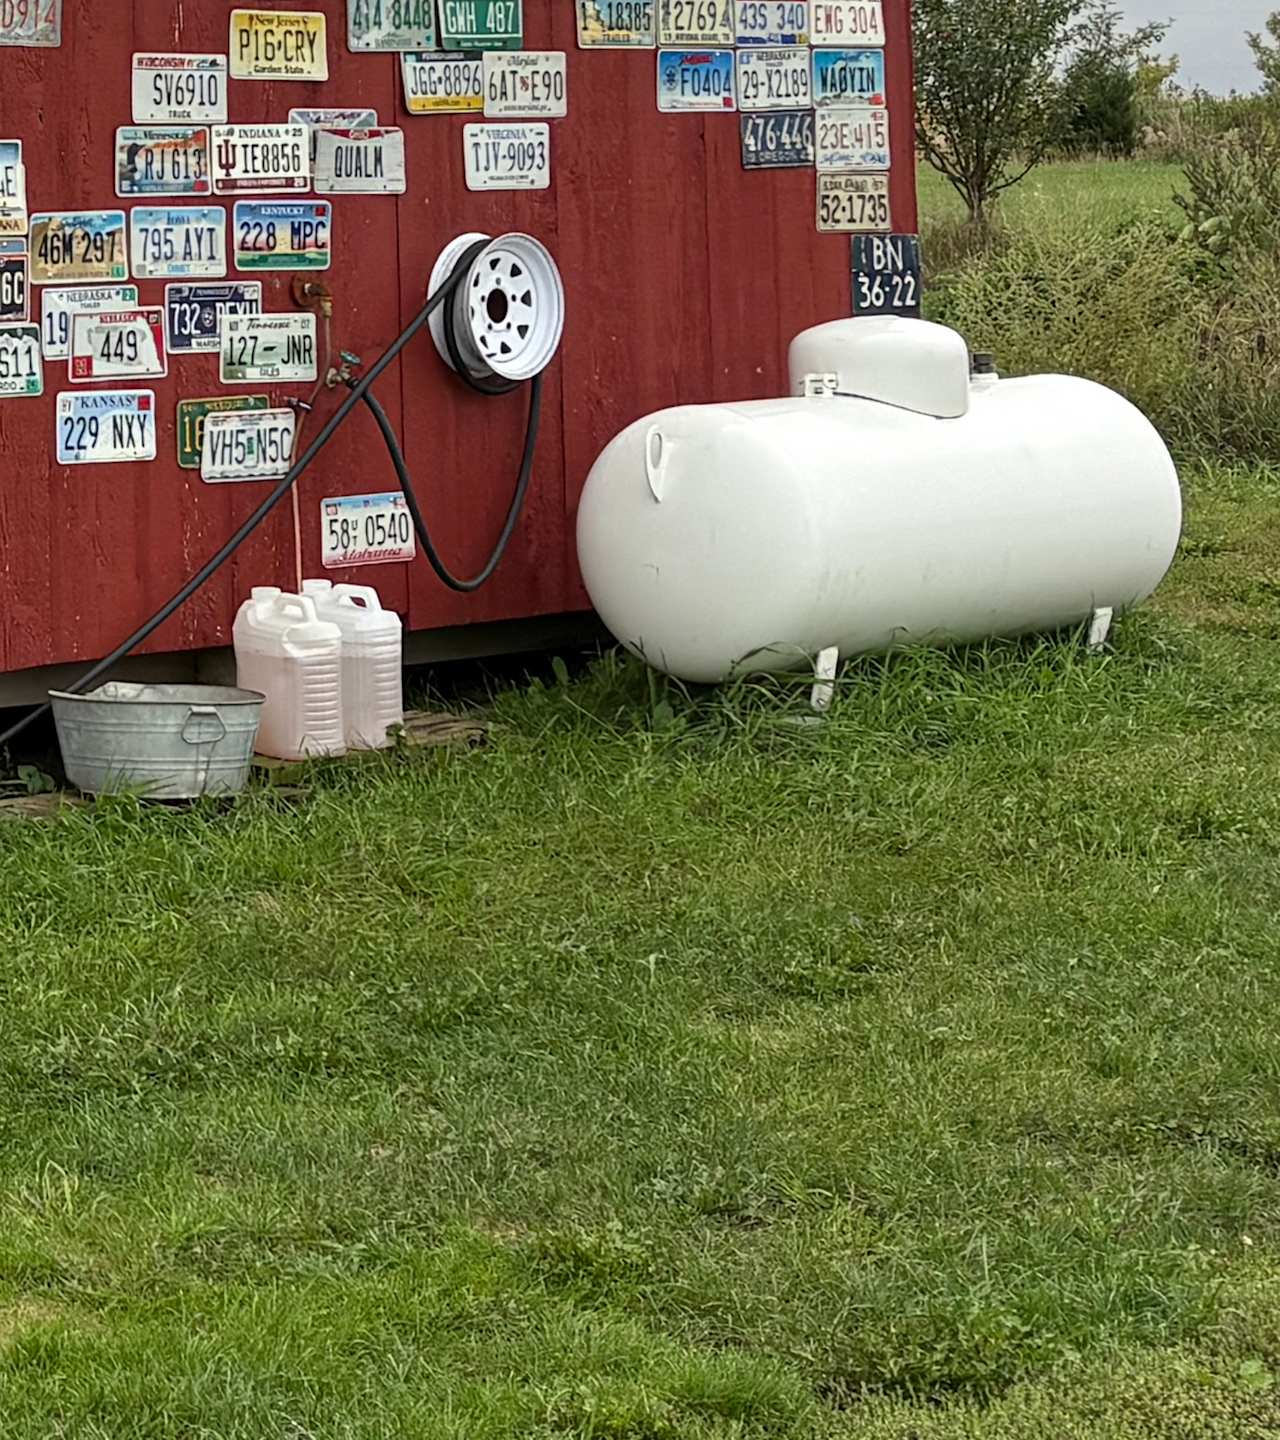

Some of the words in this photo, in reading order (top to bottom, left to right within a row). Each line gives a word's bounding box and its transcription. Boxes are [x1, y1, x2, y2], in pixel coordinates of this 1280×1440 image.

[446, 1, 477, 33] GWH
[486, 1, 514, 33] 487
[607, 1, 652, 31] 18385
[673, 0, 717, 31] 2769
[776, 2, 805, 30] 340
[848, 5, 879, 34] 304
[152, 73, 218, 106] SV6910
[742, 68, 808, 99] 29-X2189
[168, 110, 192, 118] TRUCK
[238, 128, 281, 139] INDIANA
[292, 128, 303, 137] 25
[171, 148, 202, 180] 613
[166, 211, 190, 225] Iowa
[260, 206, 305, 216] KENTUCKY
[81, 230, 116, 263] 297
[138, 227, 175, 262] 795
[183, 227, 217, 262] AYI
[239, 221, 277, 251] 228
[290, 221, 327, 250] MPC
[872, 237, 904, 271] BN
[66, 293, 113, 303] NEBRASKA
[46, 311, 68, 346] 19
[170, 302, 201, 336] 732
[246, 318, 290, 331] Tennessee
[100, 329, 138, 363] 449
[226, 336, 259, 367] 127
[281, 335, 313, 365] JNR
[80, 395, 133, 409] KANSAS
[63, 416, 99, 451] 229
[112, 414, 147, 449] NXY
[329, 518, 350, 551] 58
[365, 512, 410, 547] 0540
